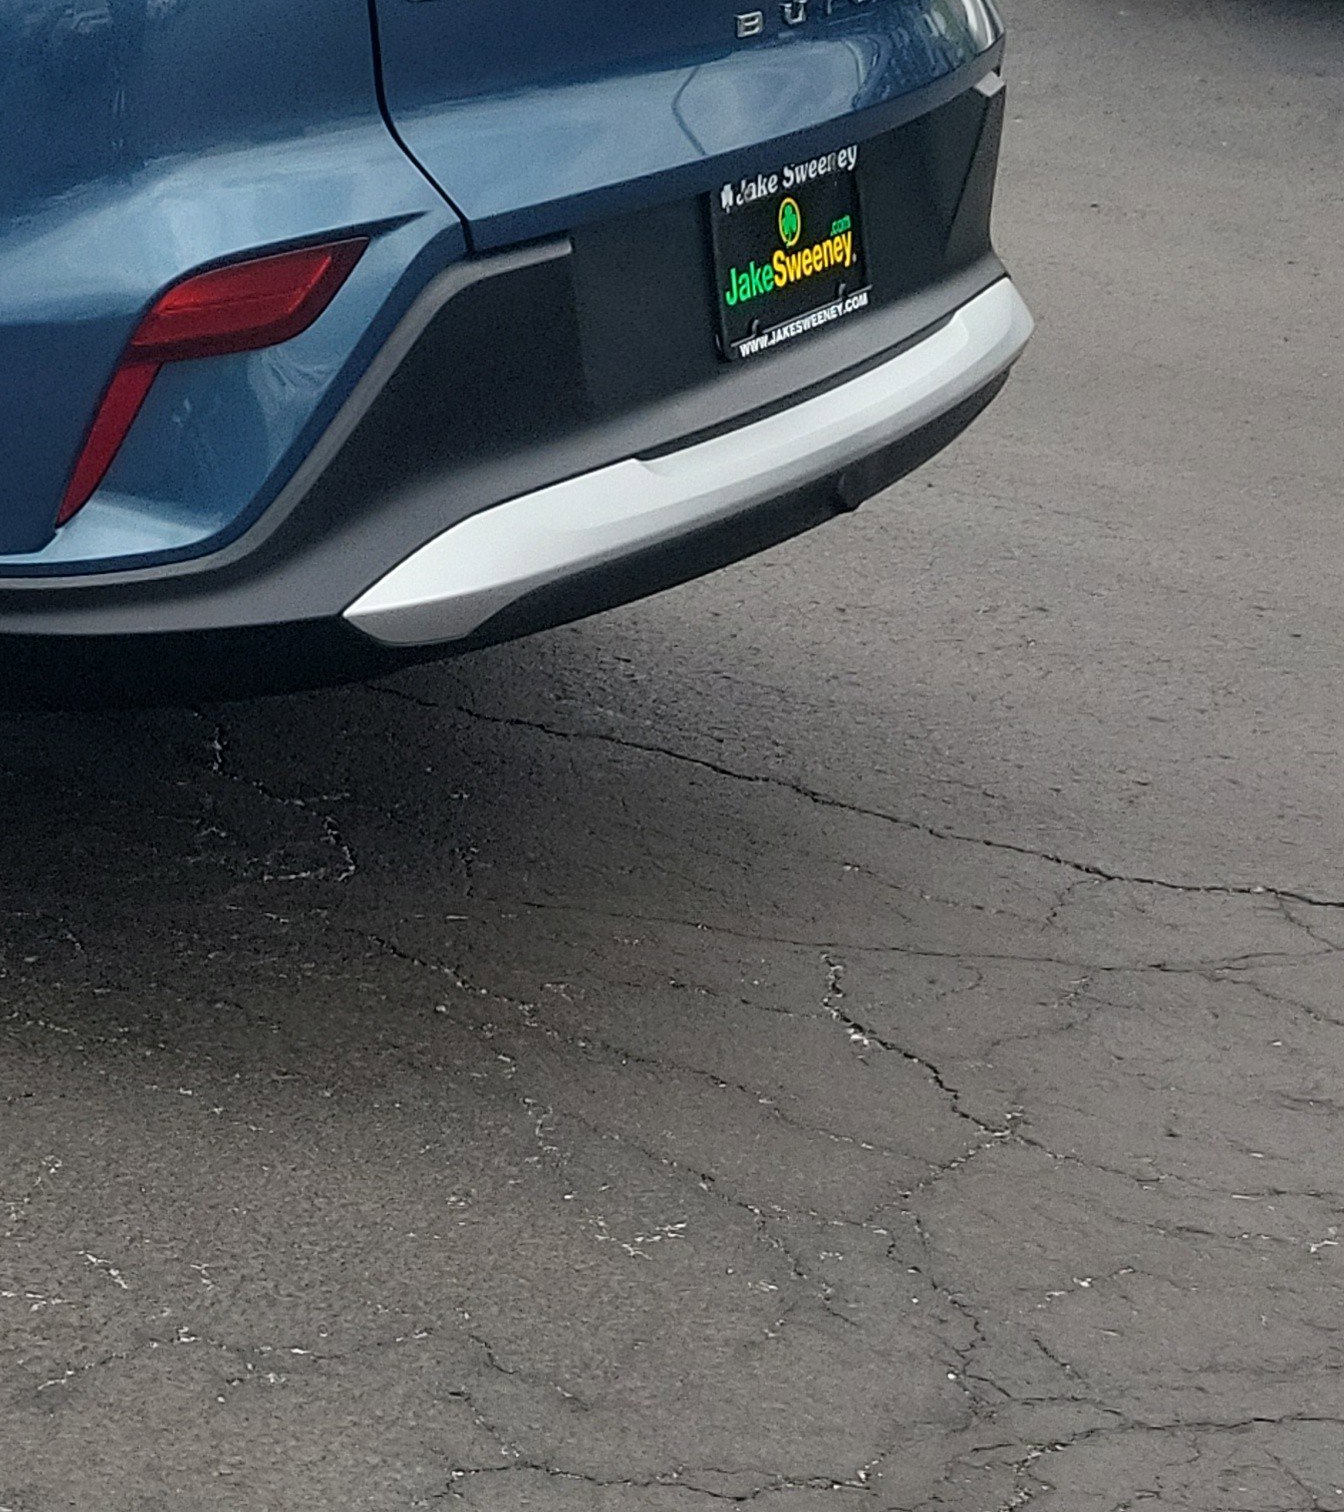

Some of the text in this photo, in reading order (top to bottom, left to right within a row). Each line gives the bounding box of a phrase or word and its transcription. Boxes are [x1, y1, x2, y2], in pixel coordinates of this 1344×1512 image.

[736, 144, 859, 206] Jake Sweeney
[724, 230, 854, 306] JakeSweeney
[738, 291, 870, 358] WWW.JAKESWEENEY.COM
